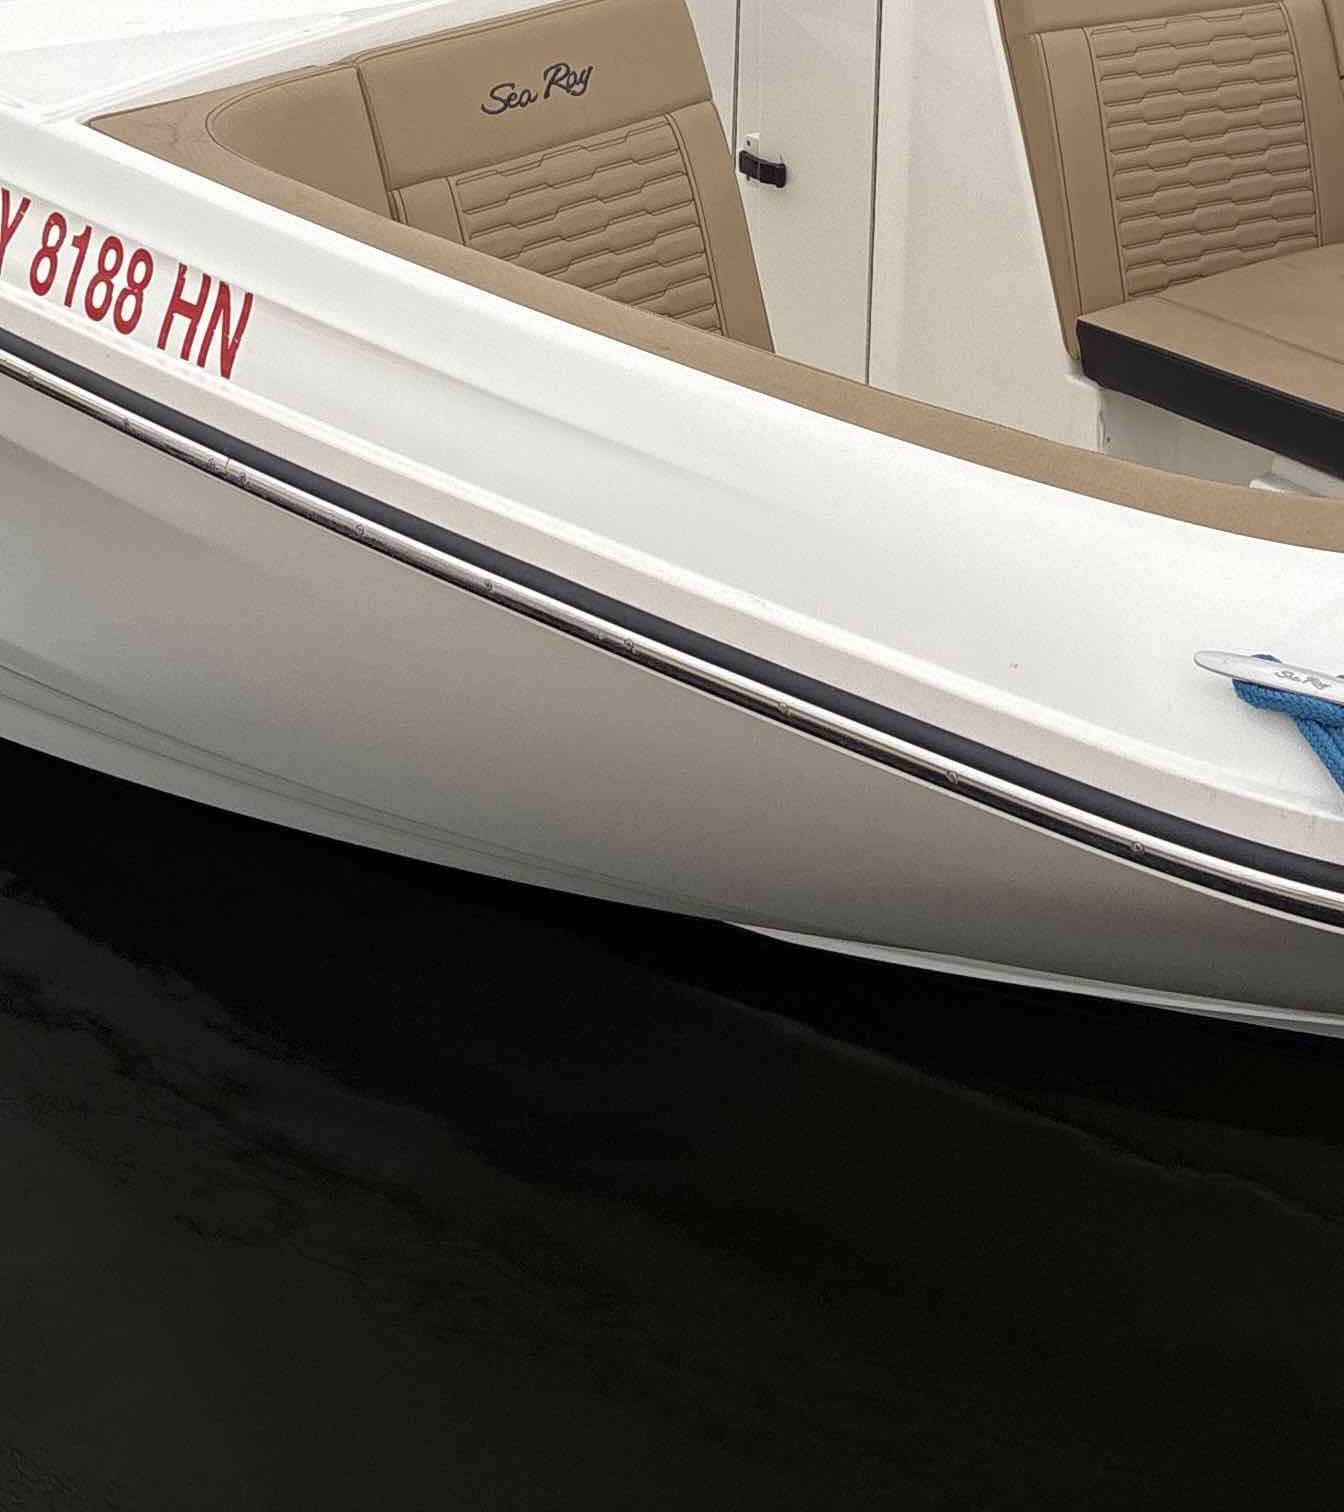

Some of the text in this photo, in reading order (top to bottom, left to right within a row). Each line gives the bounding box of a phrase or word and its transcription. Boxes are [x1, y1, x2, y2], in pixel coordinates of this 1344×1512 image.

[480, 62, 594, 115] Sea Ray
[29, 211, 154, 336] 8188
[156, 261, 254, 380] HN
